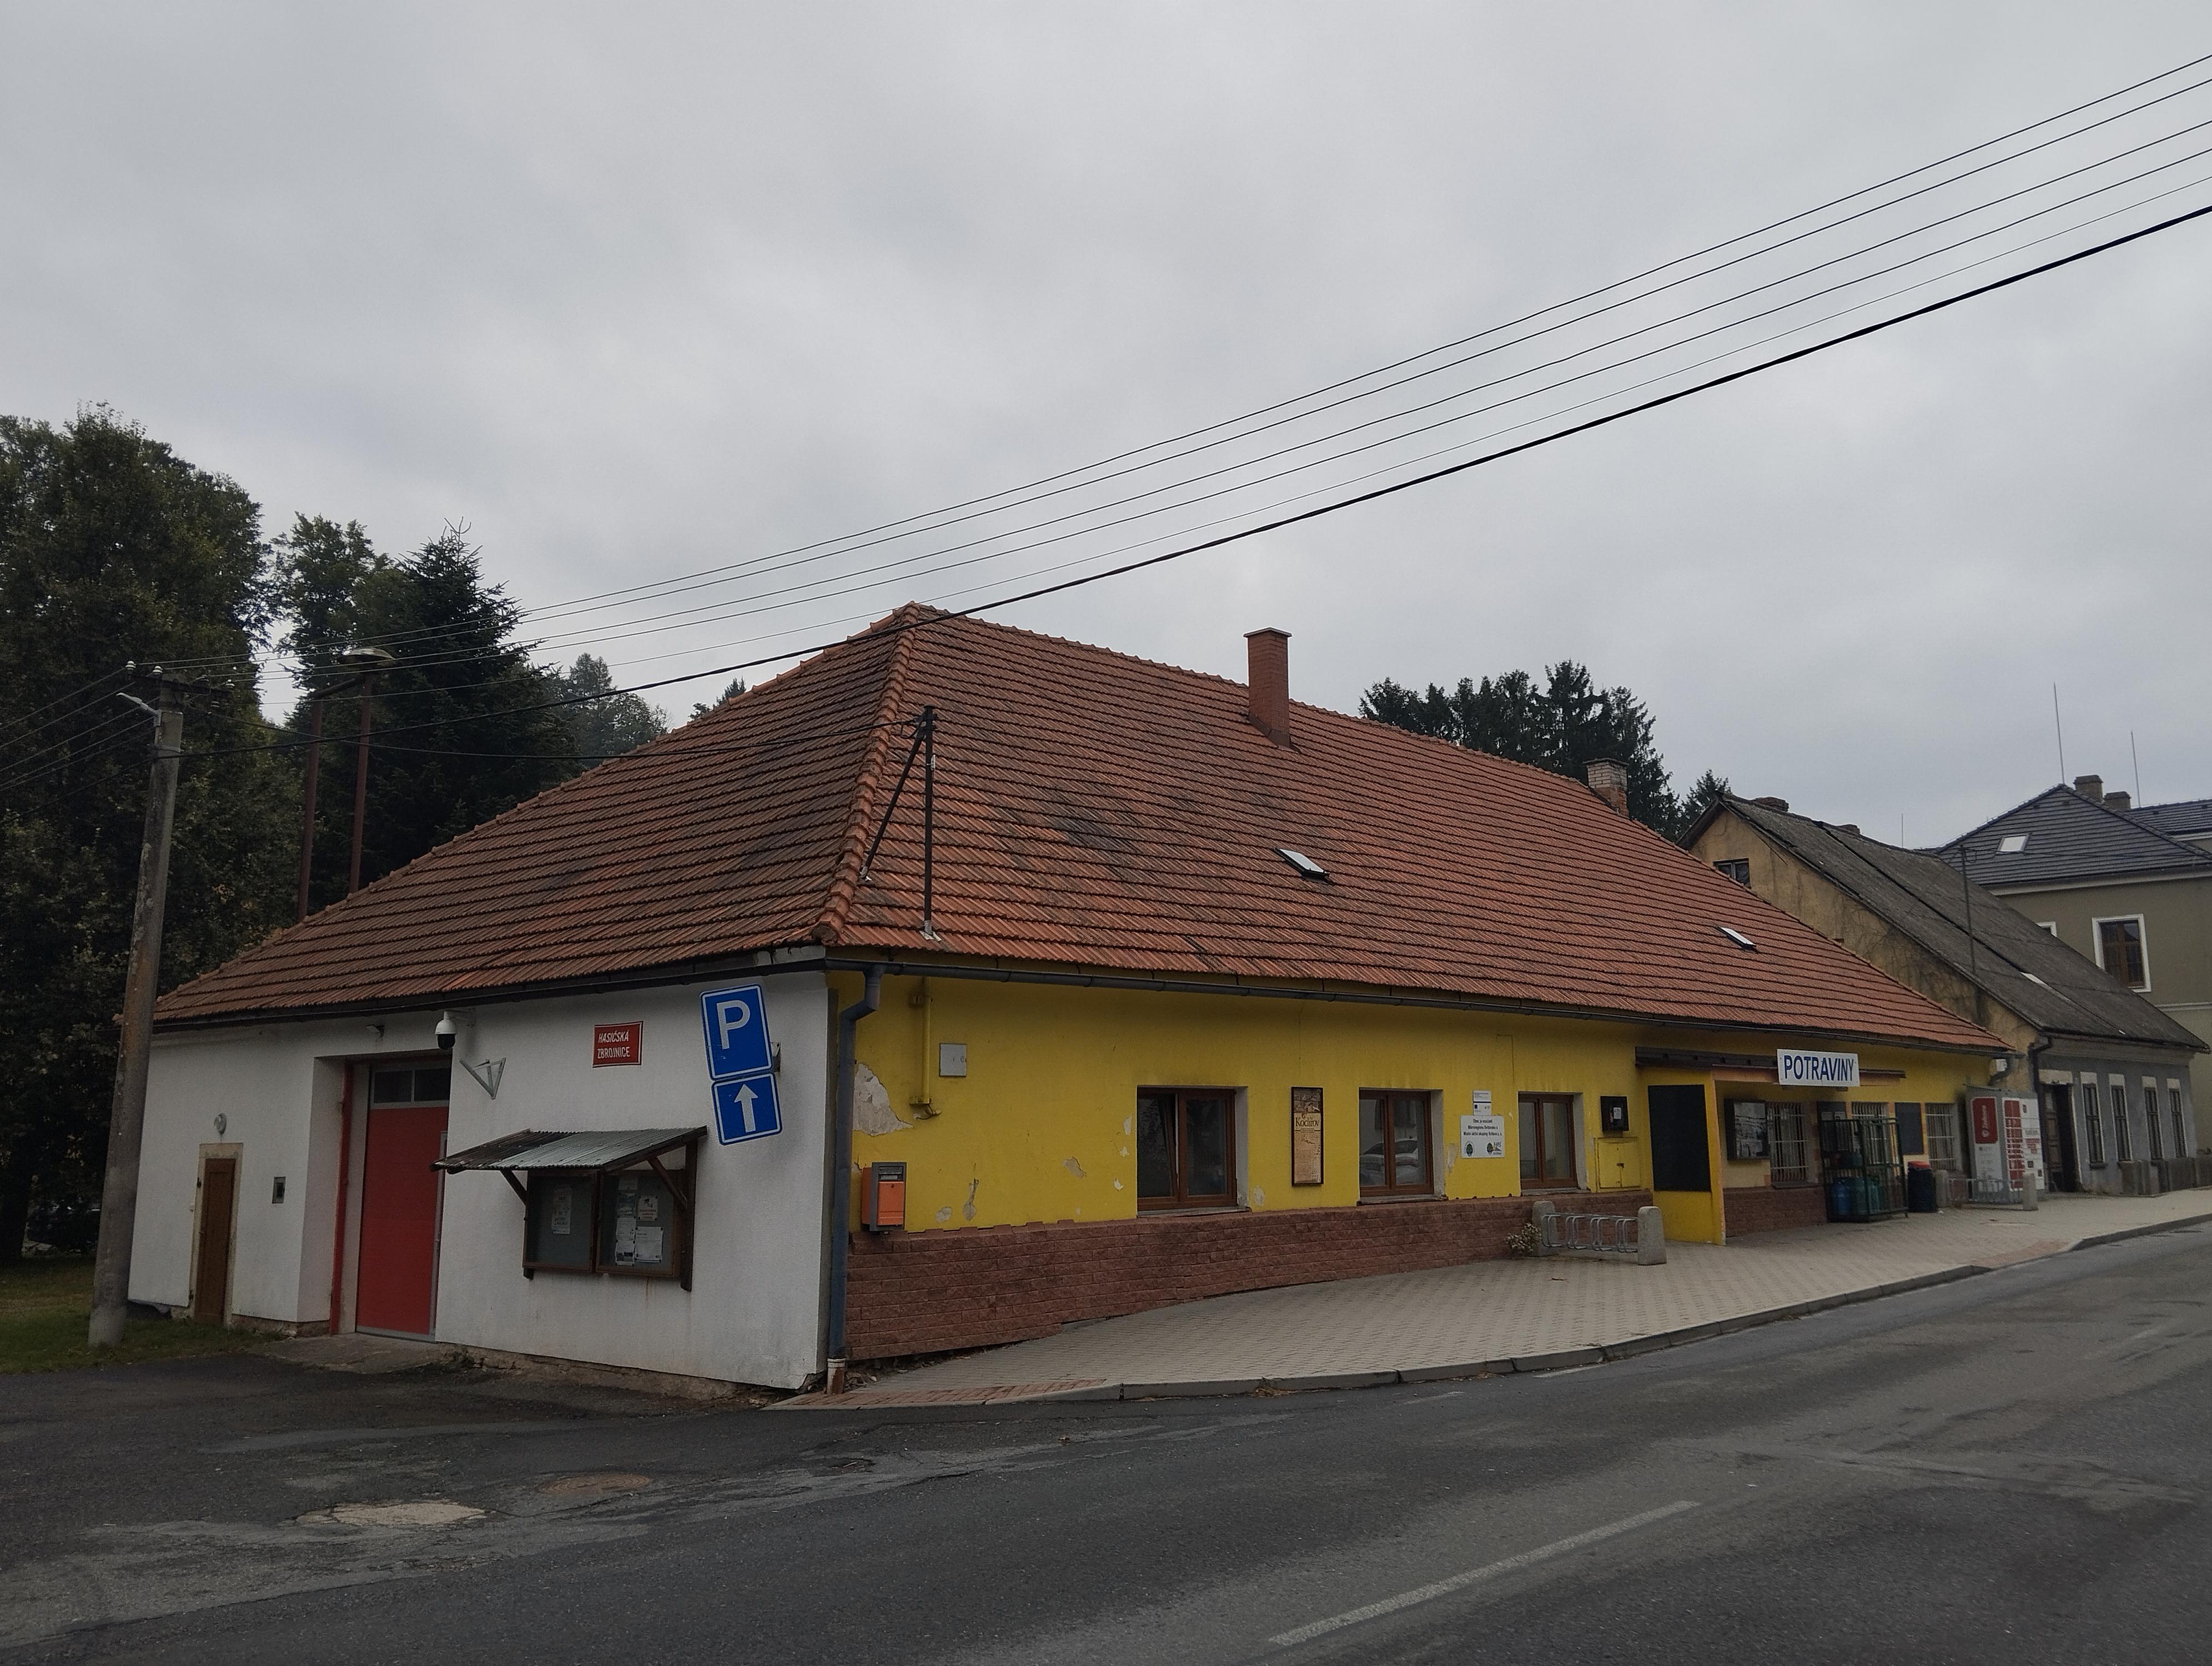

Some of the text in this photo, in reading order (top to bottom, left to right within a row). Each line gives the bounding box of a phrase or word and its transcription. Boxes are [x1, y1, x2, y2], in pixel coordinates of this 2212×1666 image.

[716, 1000, 750, 1050] P
[598, 1030, 629, 1043] HASIČSKÁ
[597, 1047, 630, 1058] ZBROJNICE
[1784, 1055, 1854, 1081] POTRAVINY
